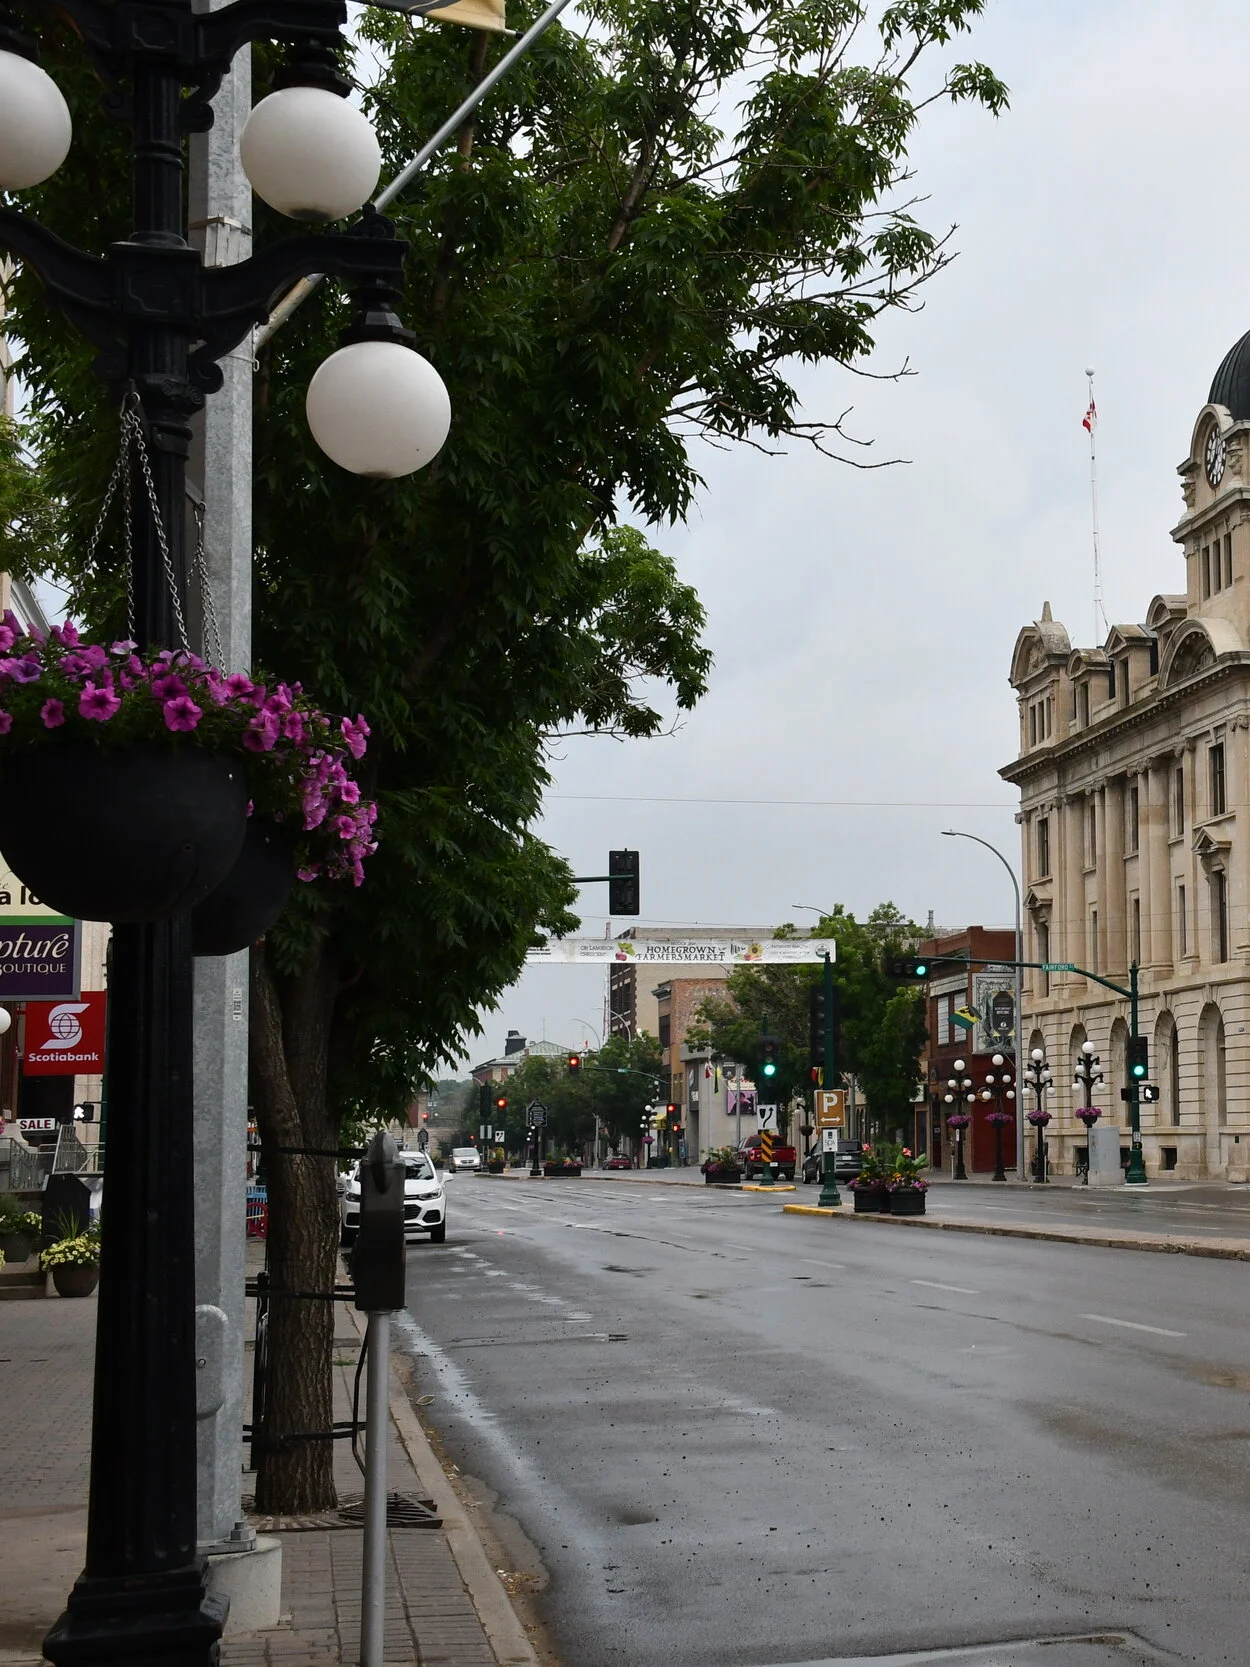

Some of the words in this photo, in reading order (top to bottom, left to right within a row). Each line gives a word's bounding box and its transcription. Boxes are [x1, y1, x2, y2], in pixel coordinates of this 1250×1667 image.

[646, 946, 716, 954] HOMEGROWN
[635, 953, 683, 961] FARMERS
[684, 953, 725, 961] MARKET
[28, 1052, 99, 1062] Scotiabank
[823, 1093, 838, 1113] P
[20, 1119, 51, 1130] SALE
